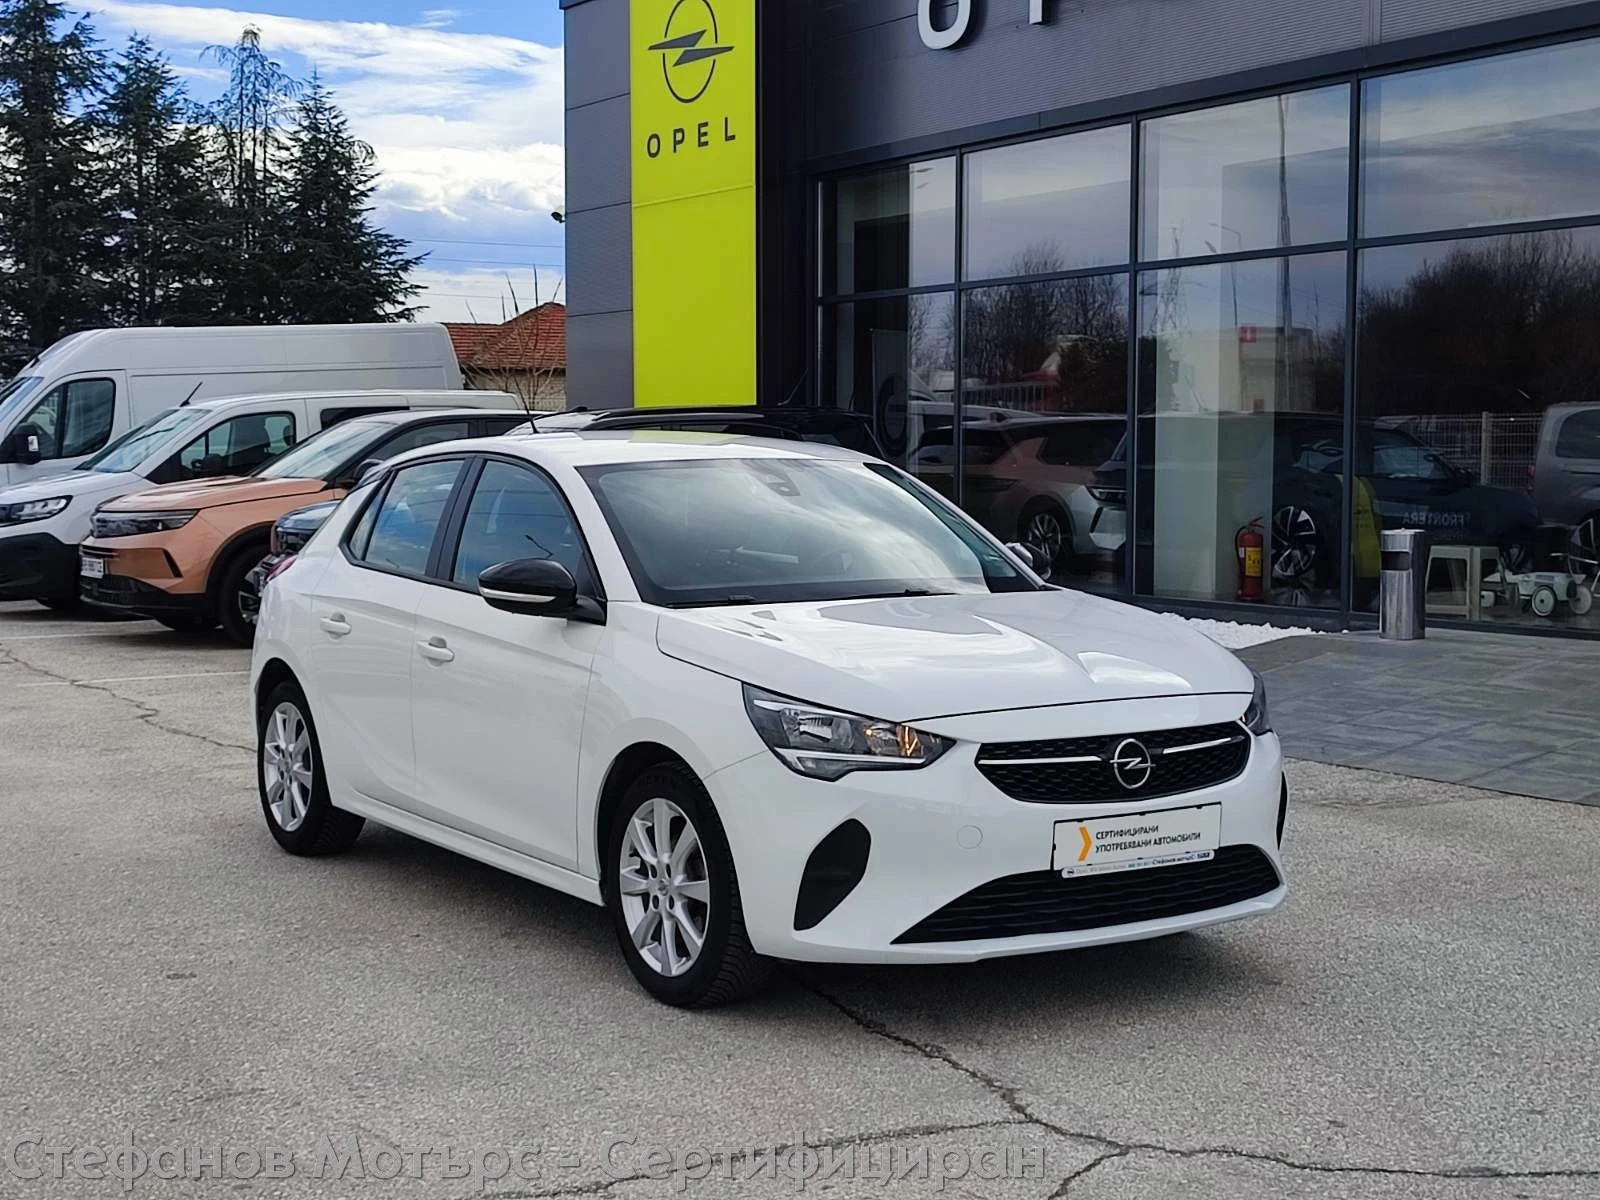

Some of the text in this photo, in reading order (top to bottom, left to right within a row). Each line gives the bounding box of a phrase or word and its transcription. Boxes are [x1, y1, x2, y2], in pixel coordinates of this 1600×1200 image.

[647, 116, 736, 158] OPEL
[1096, 825, 1159, 840] СЕРТИФИЦИРАНИ
[1096, 832, 1201, 853] УПОТРЕБЯВАНИ АВТОМОБИЛИ
